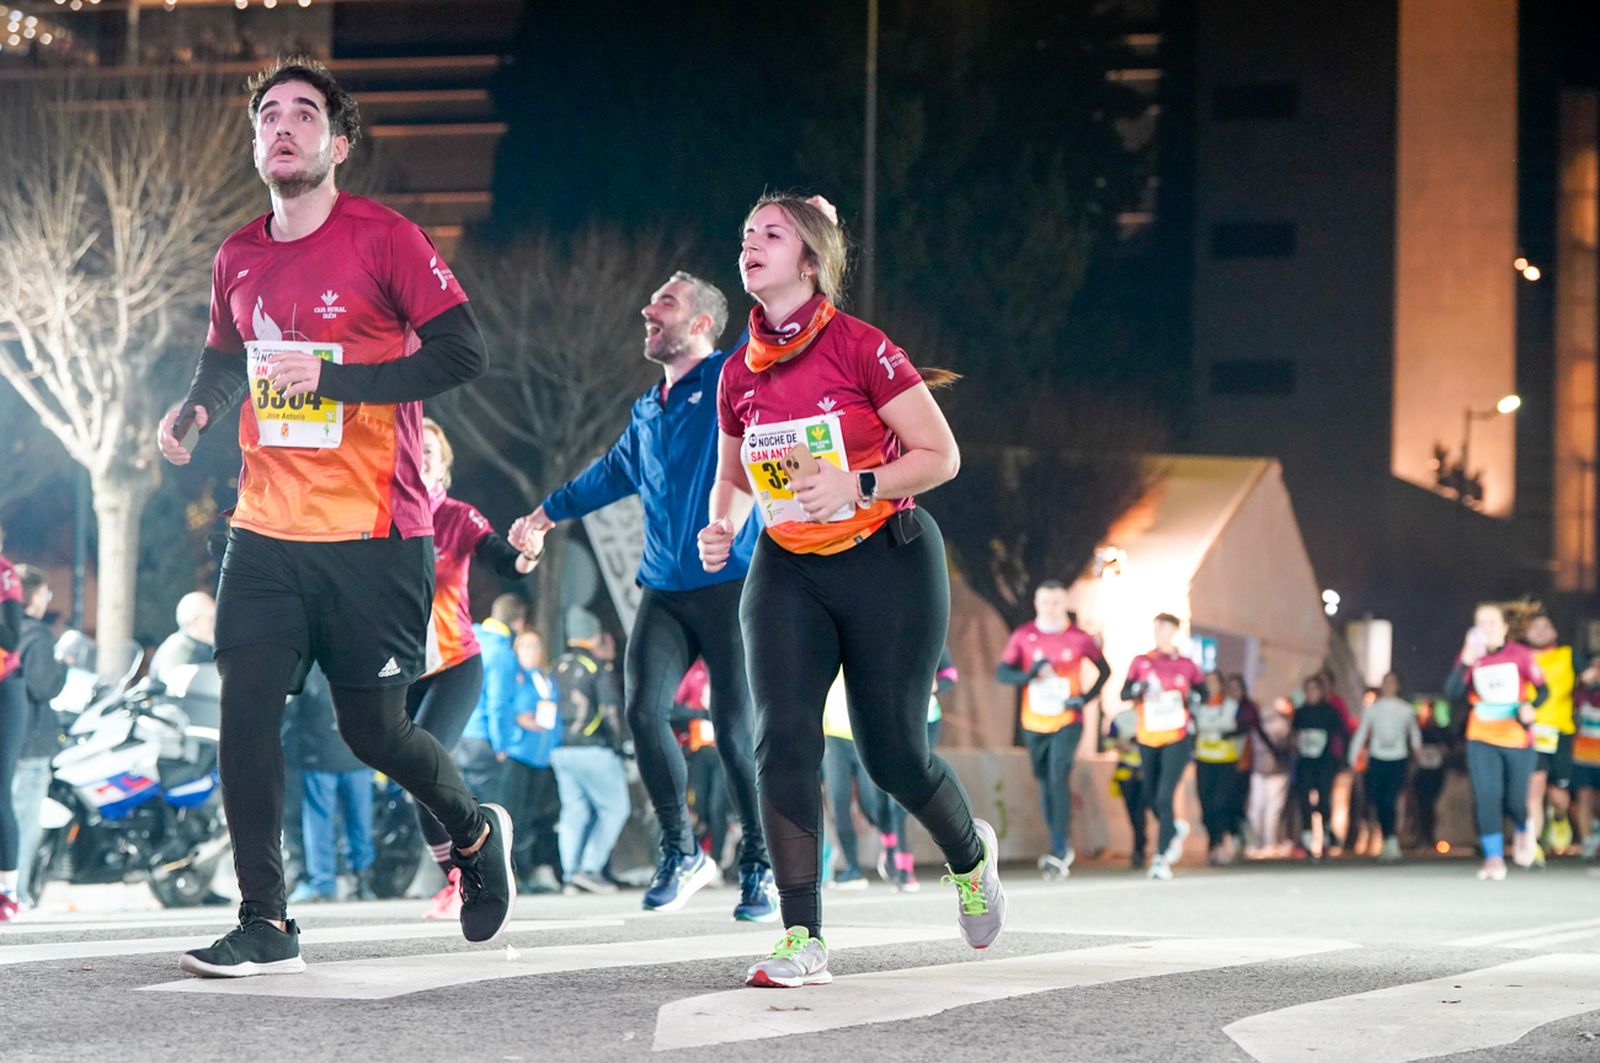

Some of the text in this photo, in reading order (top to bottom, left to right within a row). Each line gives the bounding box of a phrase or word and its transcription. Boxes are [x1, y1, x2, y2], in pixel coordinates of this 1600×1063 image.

[758, 434, 784, 447] NOCHE
[786, 432, 797, 443] DE
[751, 449, 769, 462] SAN
